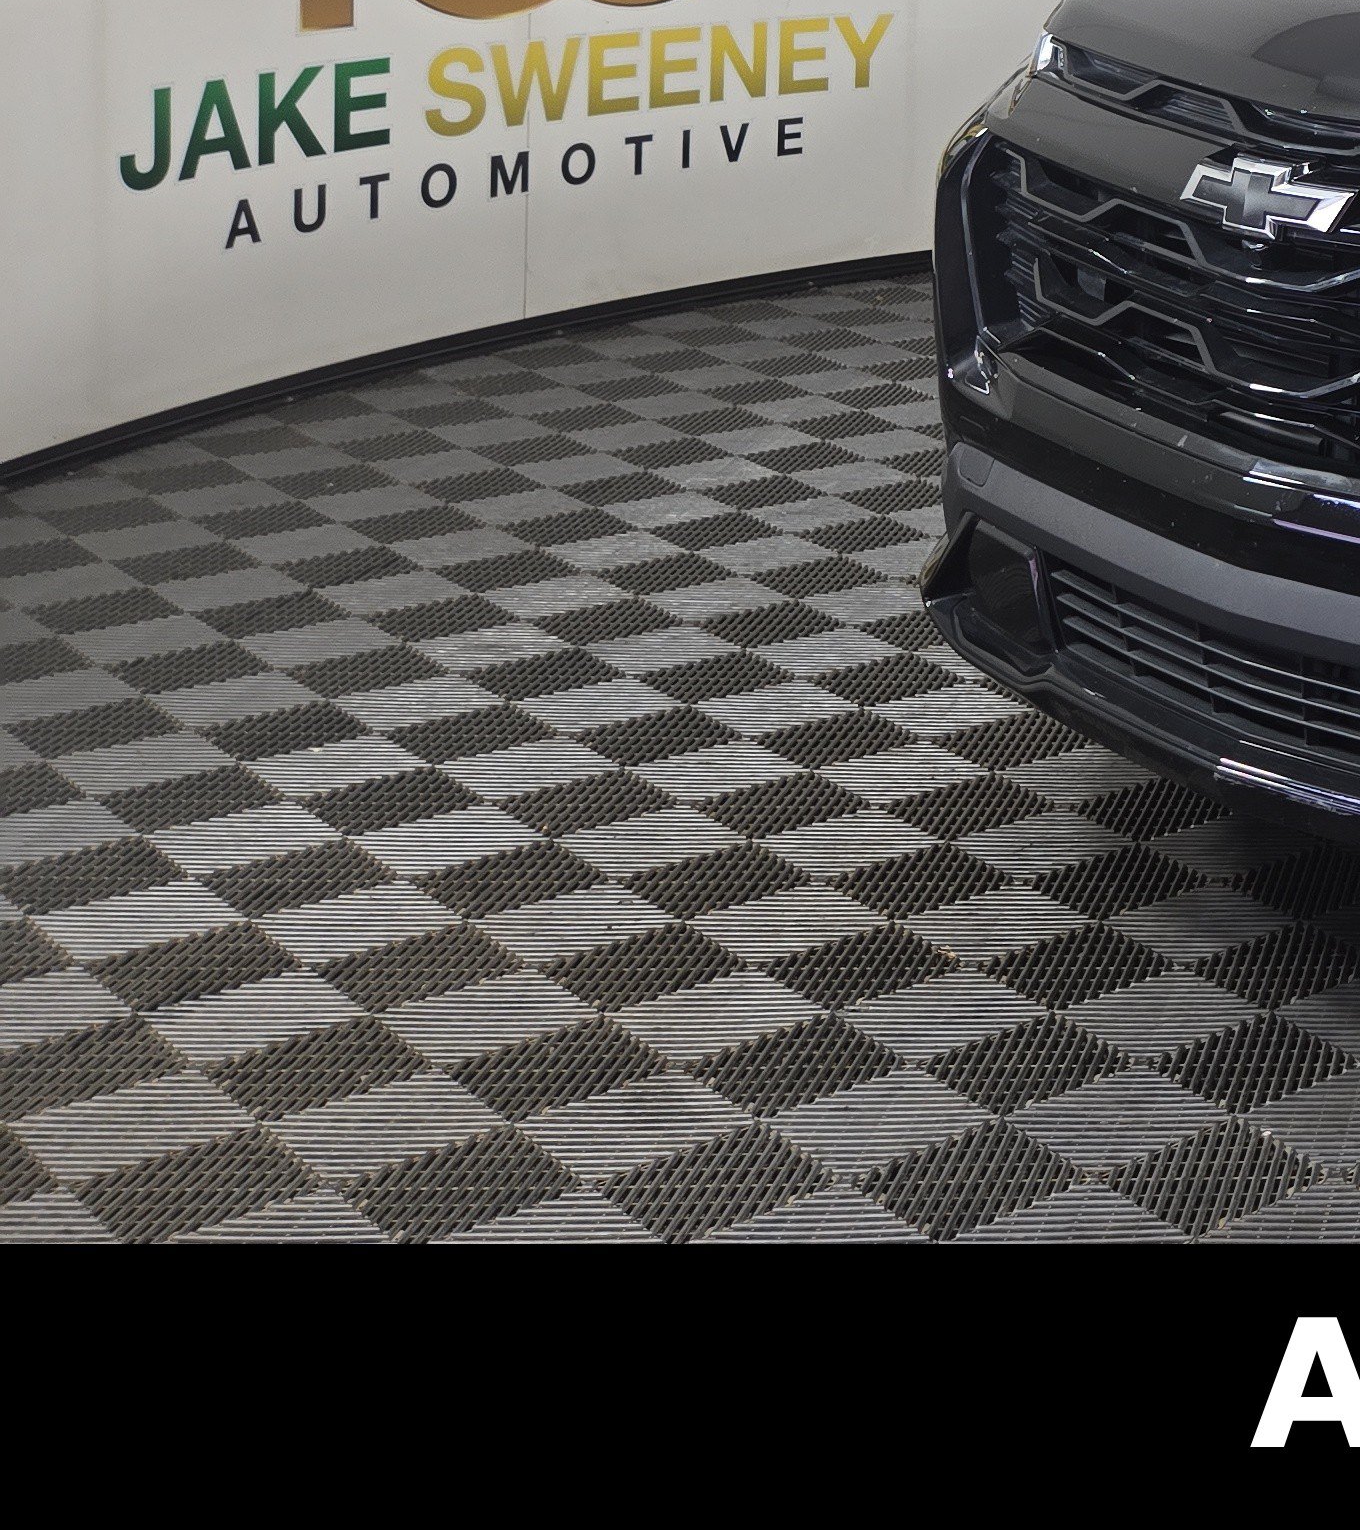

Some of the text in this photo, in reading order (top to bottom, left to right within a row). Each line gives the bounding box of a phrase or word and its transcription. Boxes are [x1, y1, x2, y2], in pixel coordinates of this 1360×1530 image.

[118, 12, 896, 192] JAKE SWEENEY
[225, 117, 804, 250] AUTOMOTIVE
